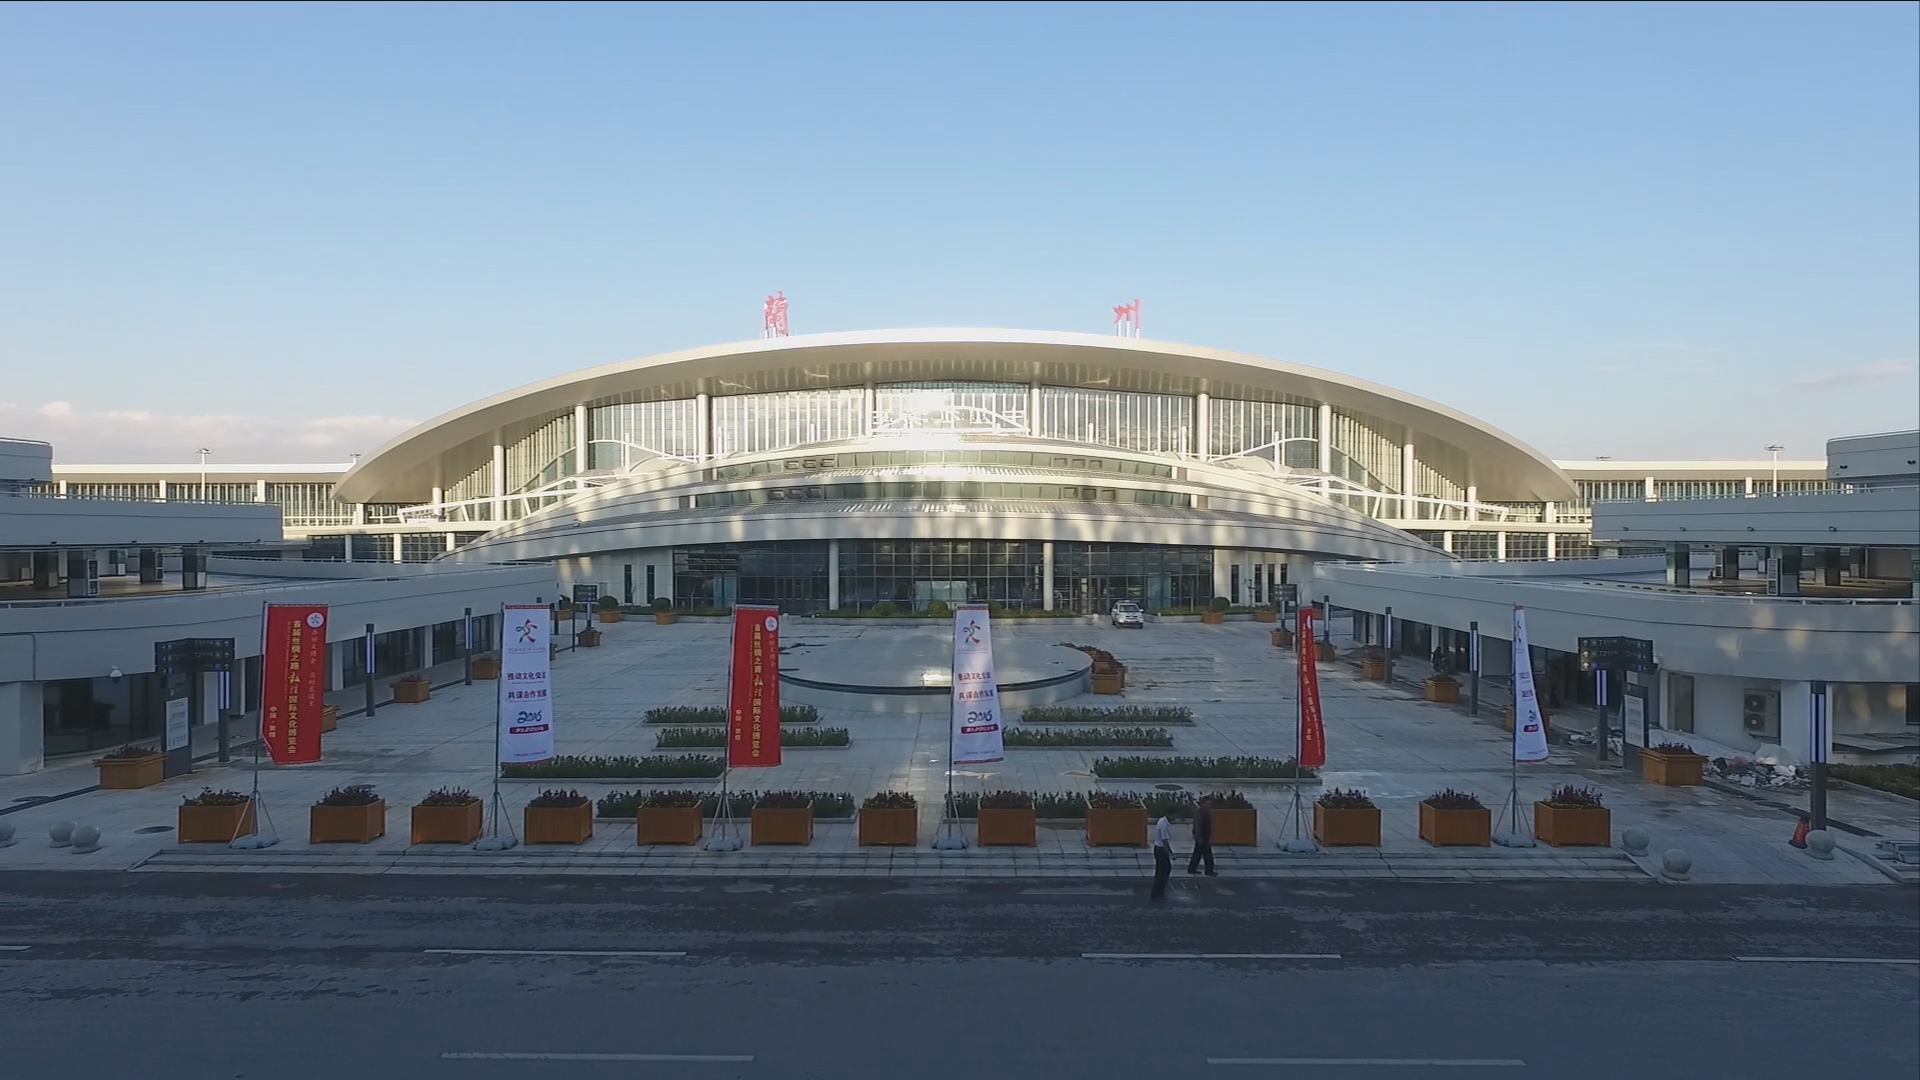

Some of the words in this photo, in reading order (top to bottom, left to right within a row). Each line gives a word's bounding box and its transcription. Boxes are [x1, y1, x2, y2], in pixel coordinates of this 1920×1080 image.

[1113, 299, 1140, 329] 州
[517, 710, 542, 724] 2016
[967, 710, 993, 724] 2016
